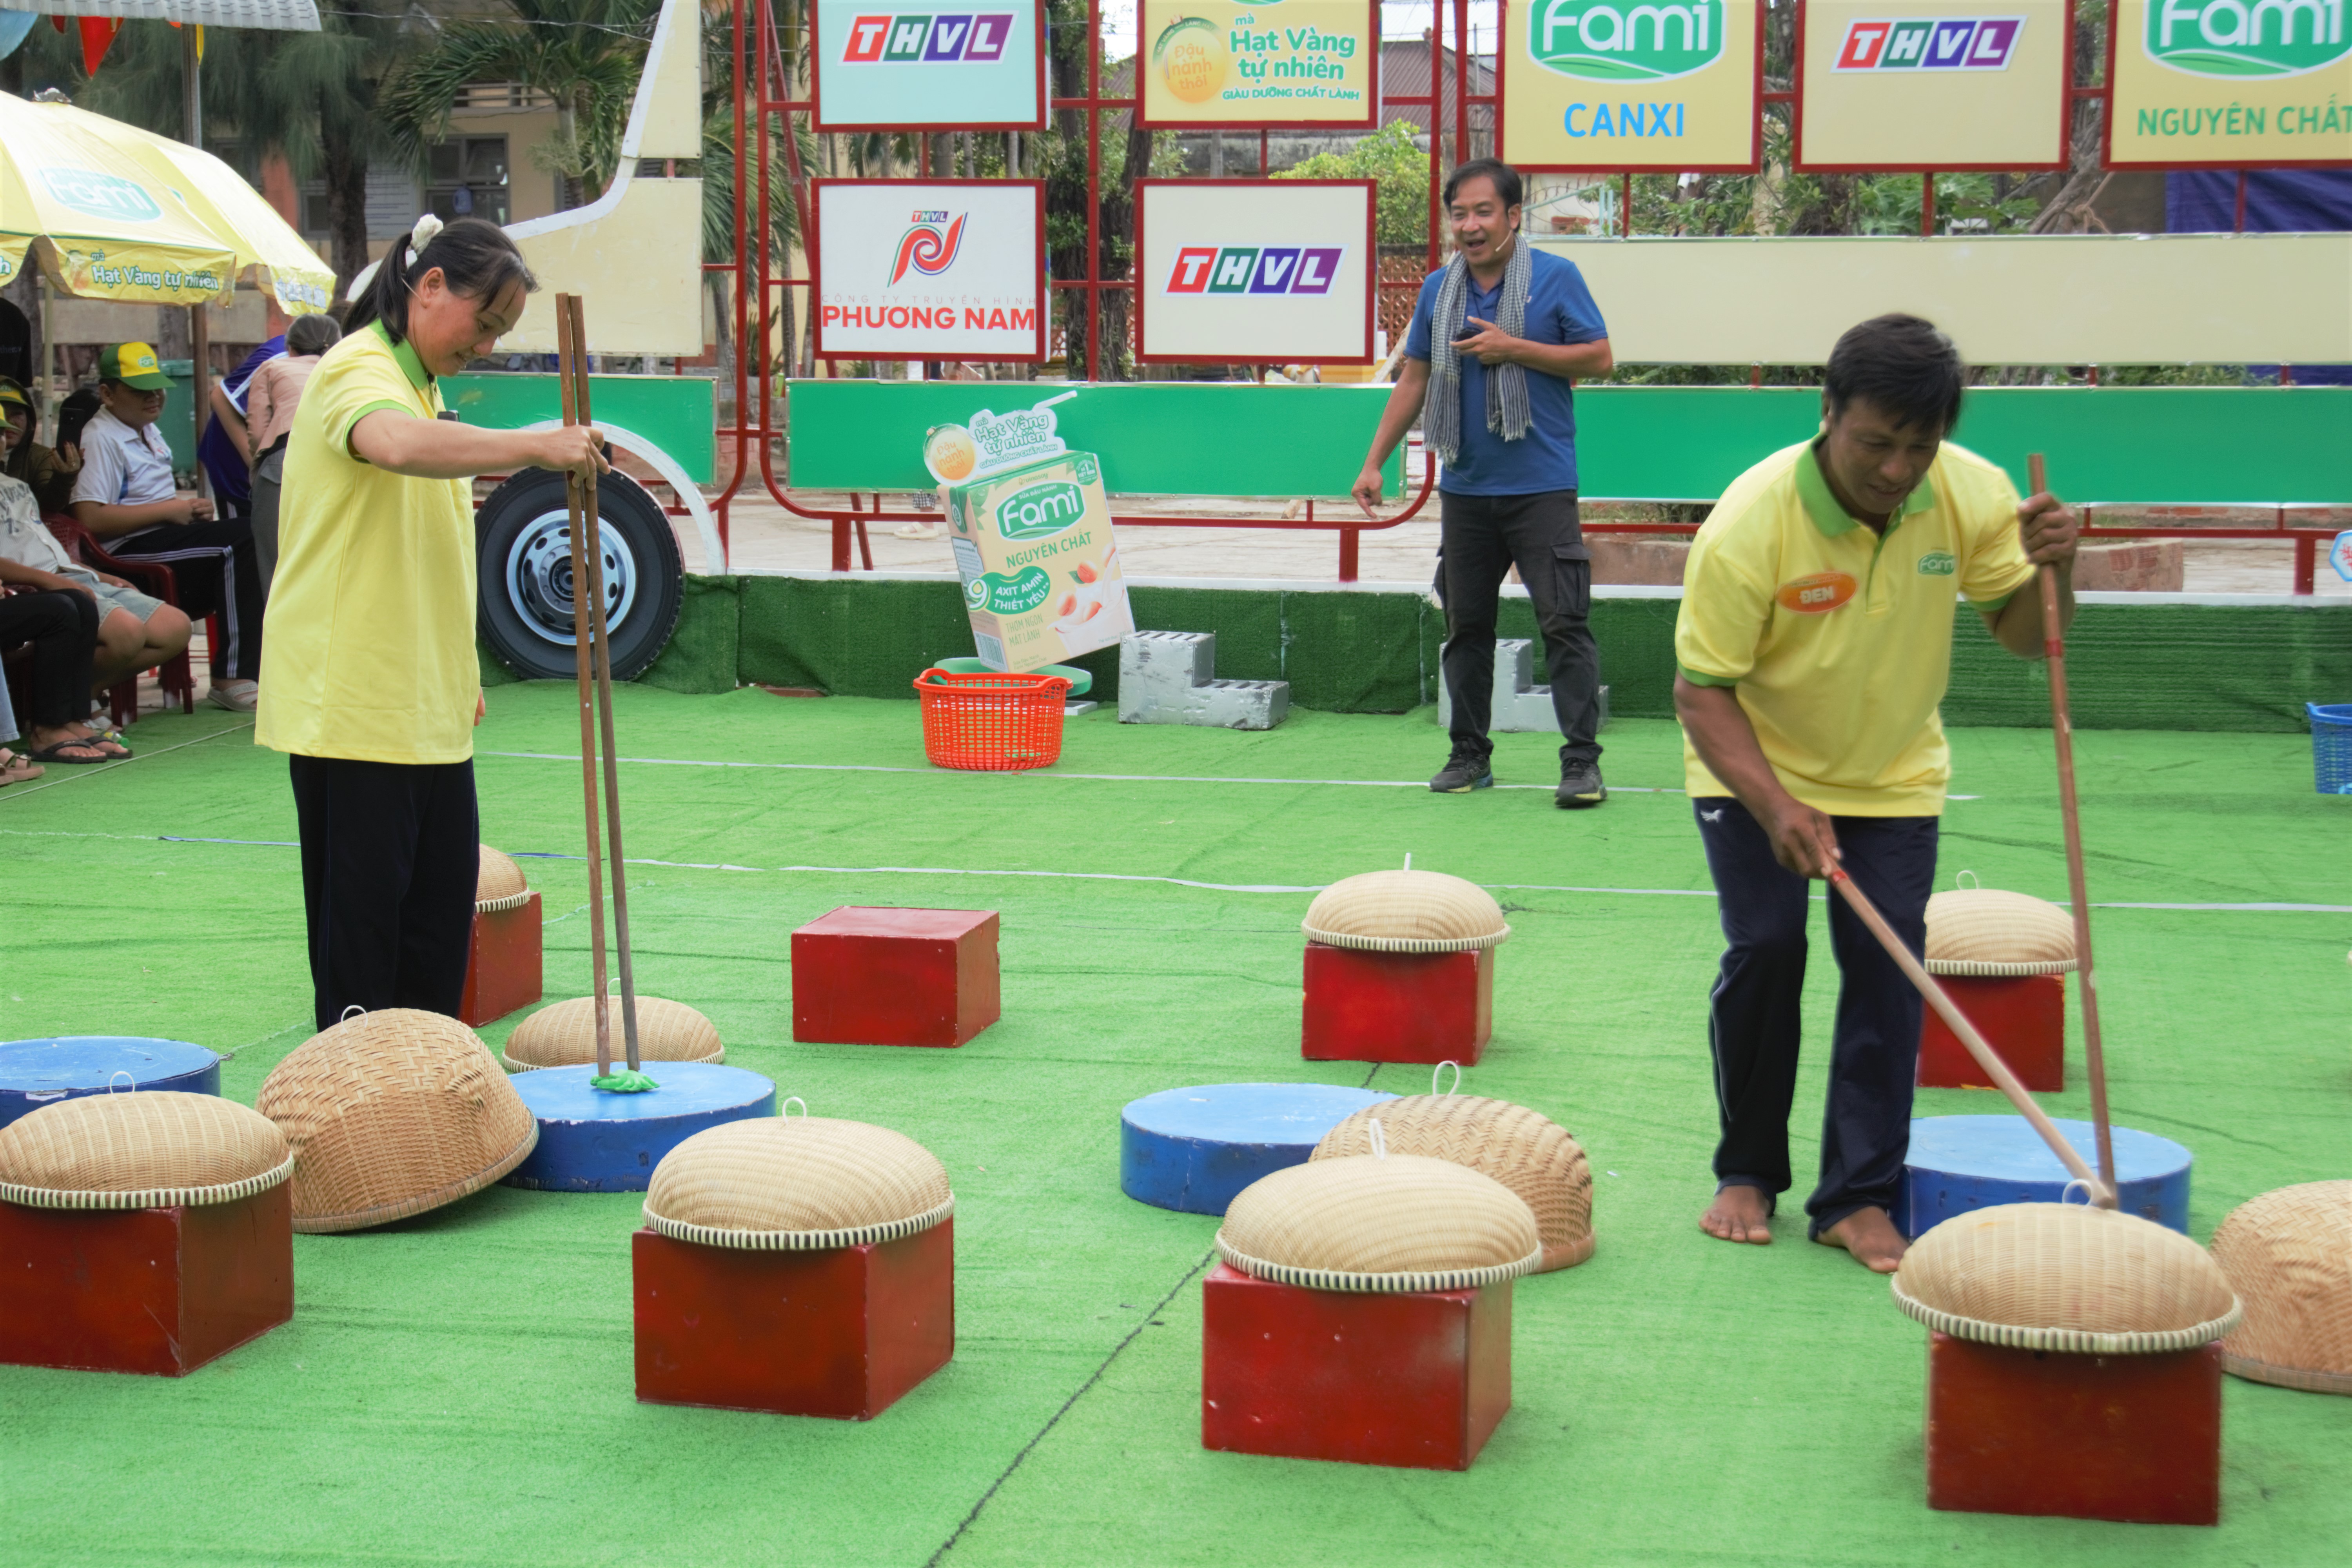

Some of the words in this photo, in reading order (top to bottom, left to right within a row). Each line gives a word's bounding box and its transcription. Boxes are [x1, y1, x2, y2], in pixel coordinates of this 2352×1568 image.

[1234, 13, 1255, 26] mà
[856, 21, 1000, 55] THVL
[1229, 29, 1279, 58] Hạt
[1285, 27, 1356, 58] Vàng
[1851, 27, 2004, 62] THVL
[1174, 43, 1205, 60] Đậu
[1172, 58, 1212, 77] nành
[1238, 58, 1269, 84] tự
[1274, 55, 1345, 80] nhiên
[1178, 75, 1208, 90] thôi
[1222, 87, 1249, 100] GIÀU
[1252, 86, 1292, 98] DƯỠNG
[1295, 85, 1326, 98] CHẤT
[1328, 87, 1359, 100] LÀNH
[1563, 103, 1685, 138] CANXI
[2137, 101, 2266, 136] NGUYÊN
[2276, 93, 2352, 135] CHẤT
[912, 211, 948, 222] THVL
[91, 249, 105, 261] mà
[92, 266, 122, 288] Hạt
[123, 266, 161, 289] Vàng
[164, 270, 181, 291] tự
[1180, 254, 1328, 287] THVL
[821, 294, 869, 303] CÔNG
[993, 294, 1036, 305] HÌNH
[822, 305, 957, 329] PHƯƠNG
[964, 307, 1035, 331] NAM
[974, 424, 1007, 443] Hạt
[1005, 415, 1049, 433] Vàng
[976, 416, 989, 427] mà
[984, 440, 1003, 456] tự
[1004, 430, 1047, 450] nhiên
[938, 447, 965, 467] nành
[979, 459, 995, 469] GIÀU
[1020, 447, 1039, 458] CHẤT
[1038, 444, 1058, 453] LÀNH
[1025, 472, 1048, 483] vinasoy
[1042, 484, 1057, 493] NÀNH
[1005, 542, 1058, 569] NGUYÊN
[1060, 528, 1092, 552] CHẤT
[968, 578, 988, 609] 9
[995, 586, 1018, 596] AXIT
[1021, 572, 1044, 593] AMIN
[994, 597, 1024, 610] THIẾT
[1798, 585, 1835, 605] ĐEN
[1005, 619, 1024, 634] THƠM
[1025, 613, 1044, 628] NGON
[1024, 628, 1041, 643] LÀNH
